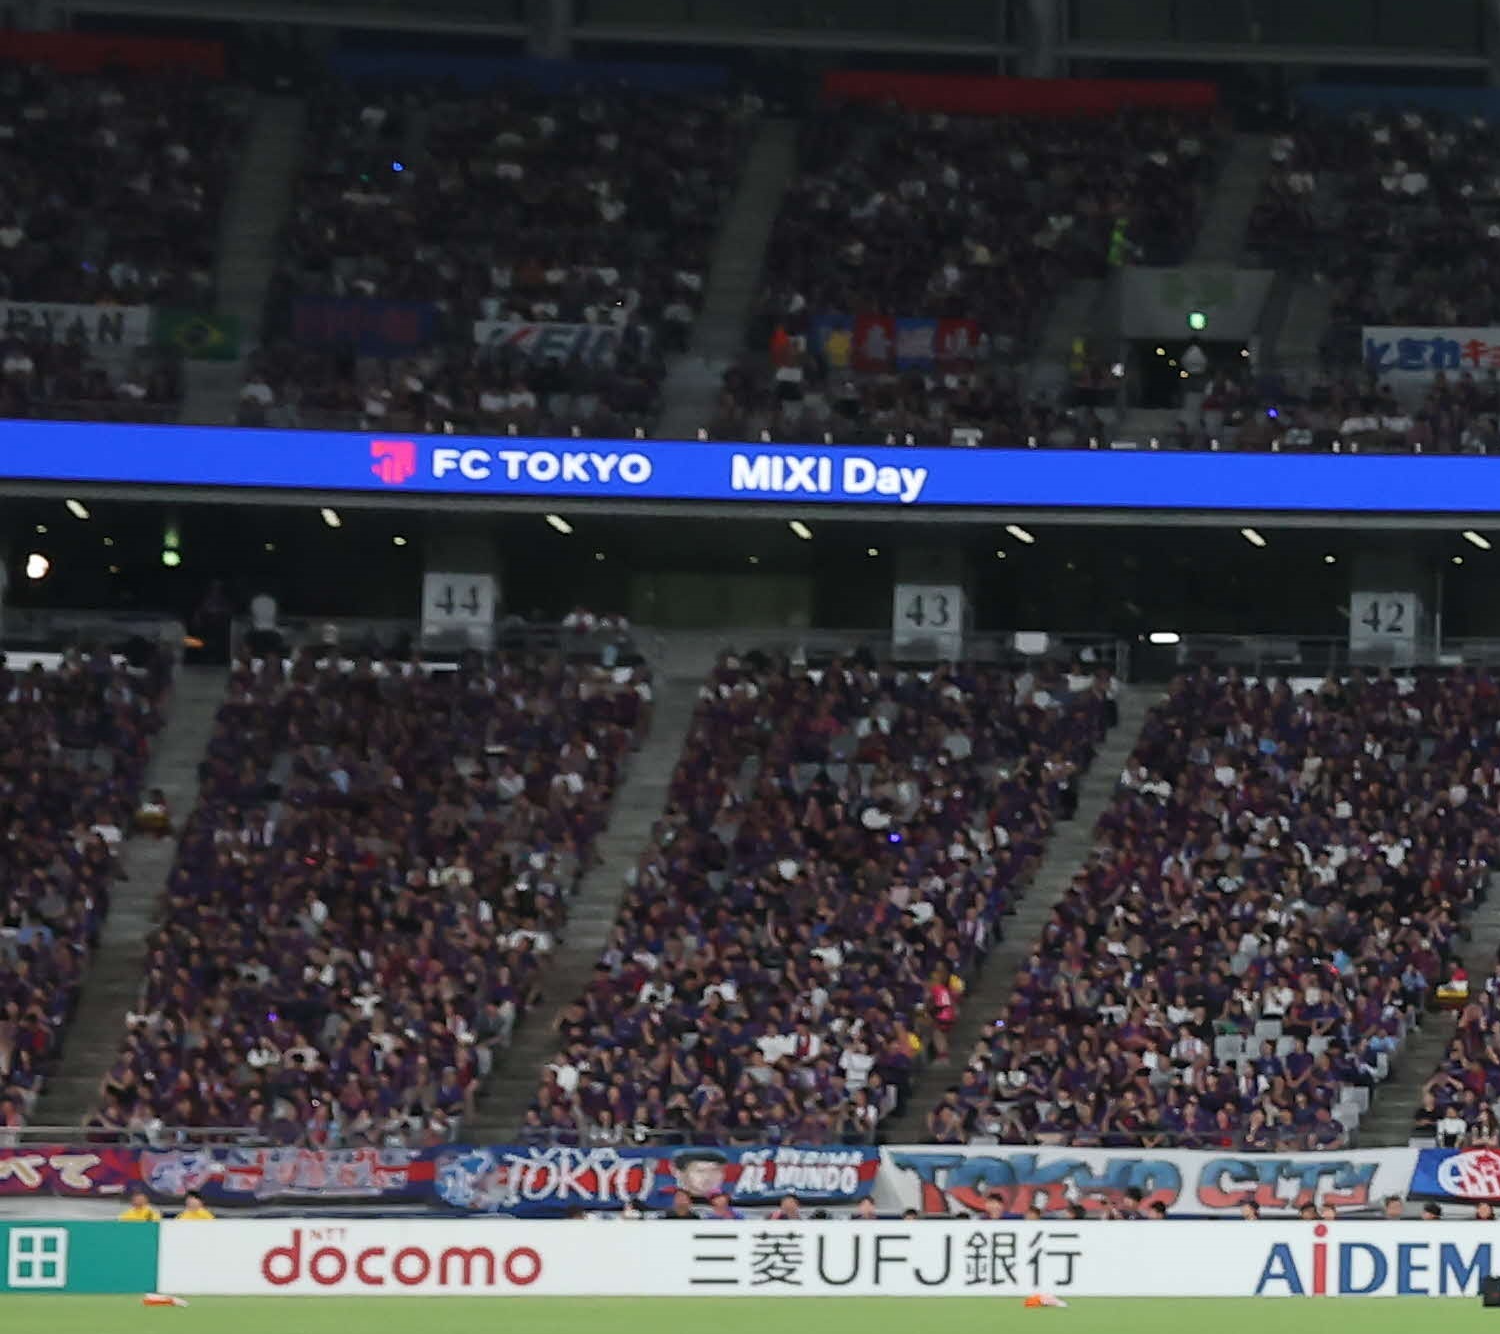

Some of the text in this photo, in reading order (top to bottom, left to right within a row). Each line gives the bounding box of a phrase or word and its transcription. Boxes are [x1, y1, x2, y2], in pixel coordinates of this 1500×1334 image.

[432, 449, 652, 484] FC TOKYO
[731, 455, 927, 503] MIXI Day
[435, 585, 480, 616] 44
[906, 593, 950, 627] 43
[1361, 600, 1406, 634] 42
[1197, 1158, 1378, 1210] CITY
[262, 1229, 543, 1285] docomo
[691, 1232, 1082, 1285] 三菱UFJ銀行
